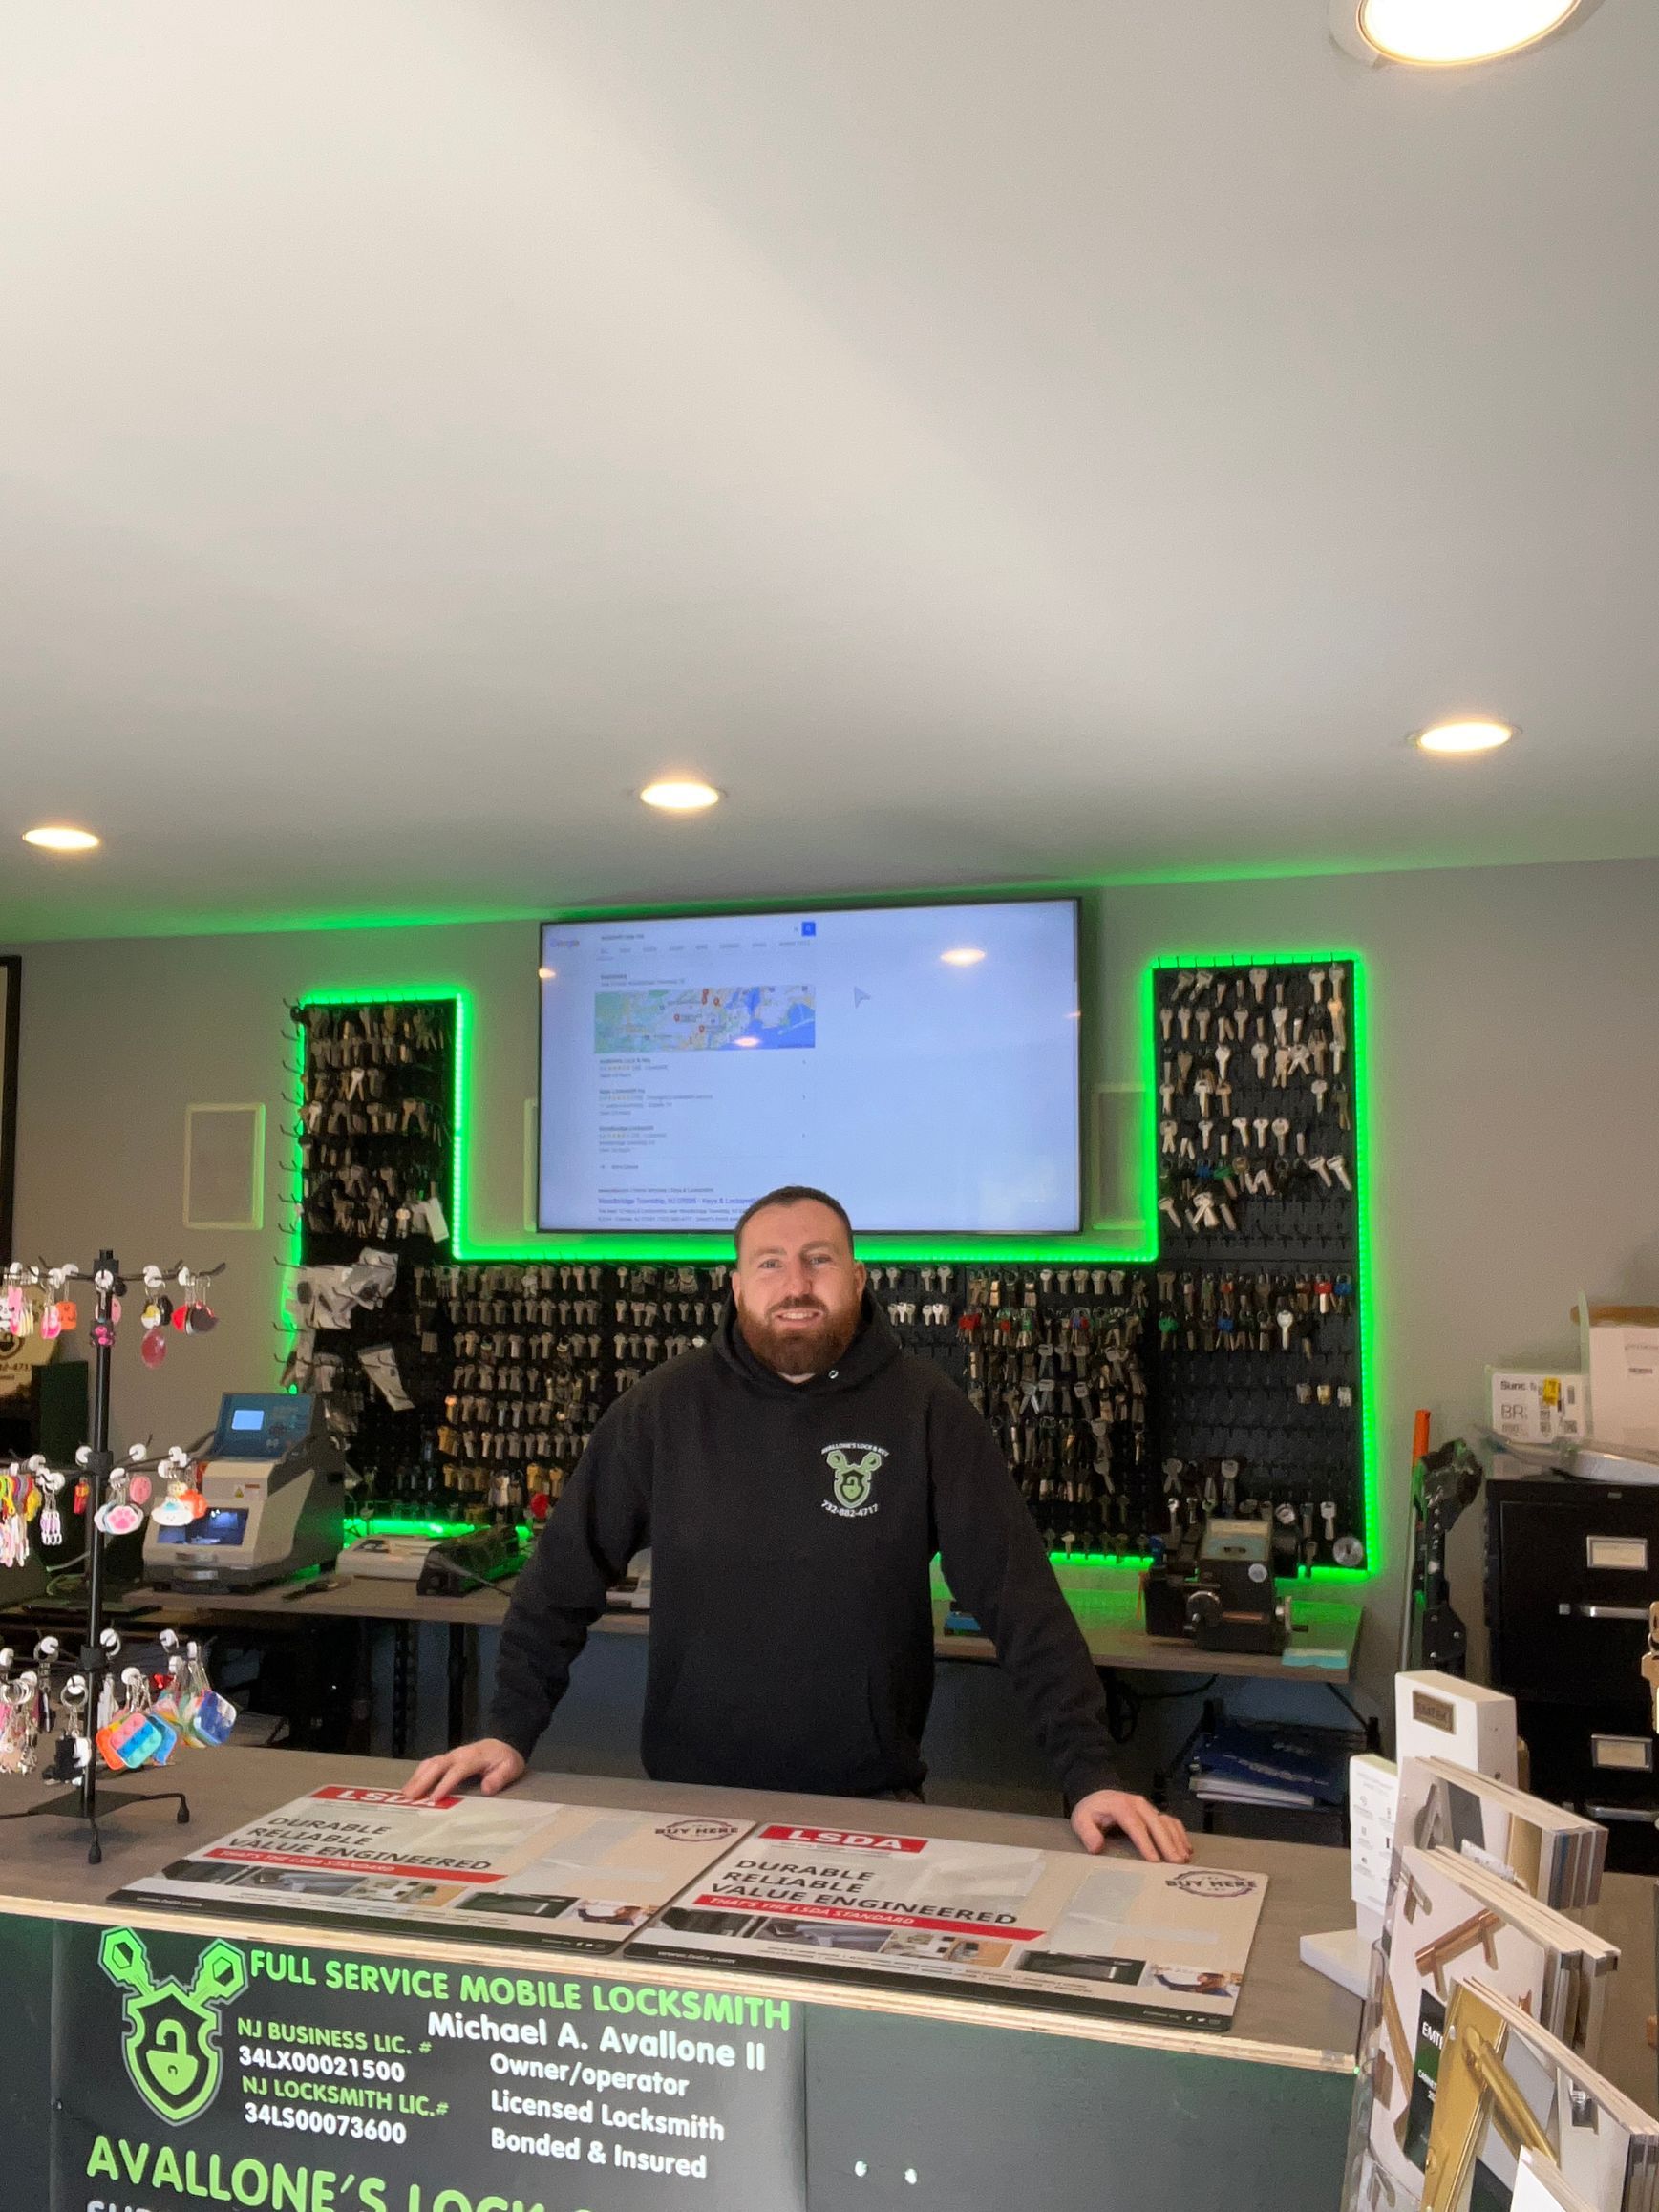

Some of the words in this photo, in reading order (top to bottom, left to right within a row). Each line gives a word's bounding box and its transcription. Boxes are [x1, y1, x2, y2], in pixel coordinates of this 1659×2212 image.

[246, 1826, 374, 1846] RELIABLE
[267, 1816, 393, 1836] DURABLE
[787, 1829, 904, 1851] LSDA
[227, 1837, 314, 1854] VALUE
[317, 1845, 492, 1871] ENGINEERED
[734, 1859, 876, 1882] DURABLE
[722, 1871, 866, 1894] RELIABLE
[1165, 1879, 1202, 1887] BUY
[1208, 1880, 1258, 1888] HERE
[709, 1897, 761, 1908] THAT'S
[763, 1901, 791, 1911] THE
[790, 1905, 831, 1916] LSDA
[834, 1909, 915, 1925] STANDARD
[711, 1882, 807, 1902] VALUE
[813, 1893, 1018, 1925] ENGINEERED
[250, 1949, 317, 1986] FULL
[325, 1960, 451, 2001] SERVICE
[459, 1974, 583, 2010] MOBILE
[592, 1984, 792, 2031] LOCKSMITH
[237, 2016, 263, 2039] NJ
[266, 2021, 369, 2051] BUSINESS
[372, 2033, 414, 2055] LIC.
[417, 2040, 434, 2054] #
[427, 2010, 548, 2047] Michael
[557, 2021, 590, 2051] A.
[599, 2025, 737, 2068] Avallone
[744, 2040, 767, 2072] II
[238, 2045, 407, 2083] 34LX00021500
[489, 2052, 691, 2097] Owner/operator
[242, 2075, 268, 2096] NJ
[273, 2078, 393, 2112] LOCKSMITH
[245, 2101, 408, 2145] 34LS00073600
[490, 2088, 594, 2124] Licensed
[601, 2103, 725, 2141] Locksmith
[490, 2126, 582, 2161] Bonded
[587, 2139, 607, 2165] &
[613, 2143, 708, 2179] Insured
[86, 2135, 387, 2212] AVALLONE'S
